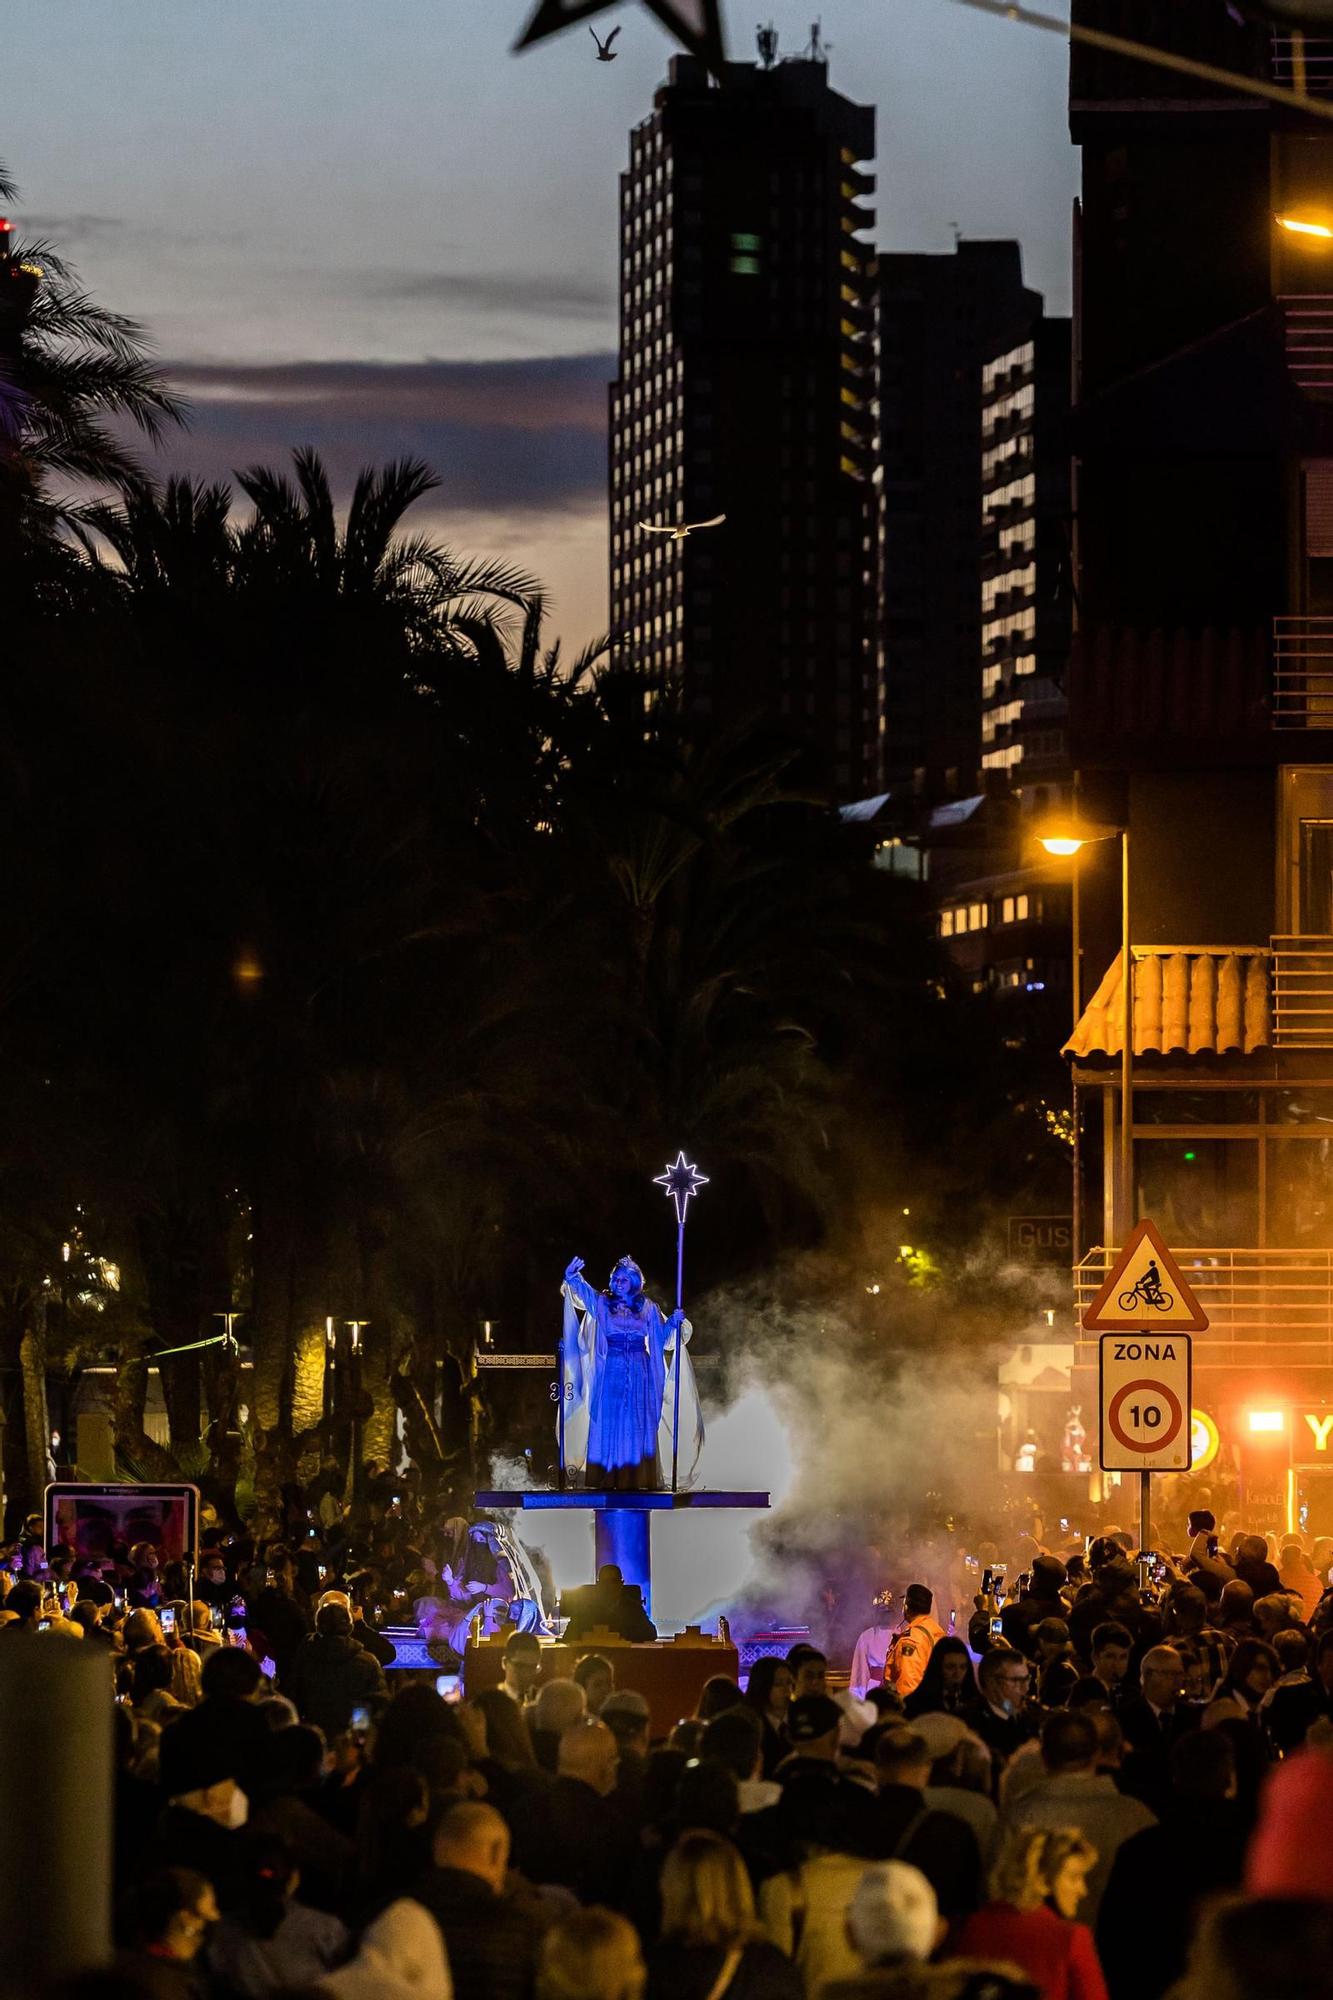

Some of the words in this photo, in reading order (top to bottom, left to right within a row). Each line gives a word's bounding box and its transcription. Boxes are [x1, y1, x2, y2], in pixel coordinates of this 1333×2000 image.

[1114, 1343, 1177, 1361] ZONA
[1129, 1405, 1162, 1428] 10
[1304, 1414, 1333, 1451] Y
